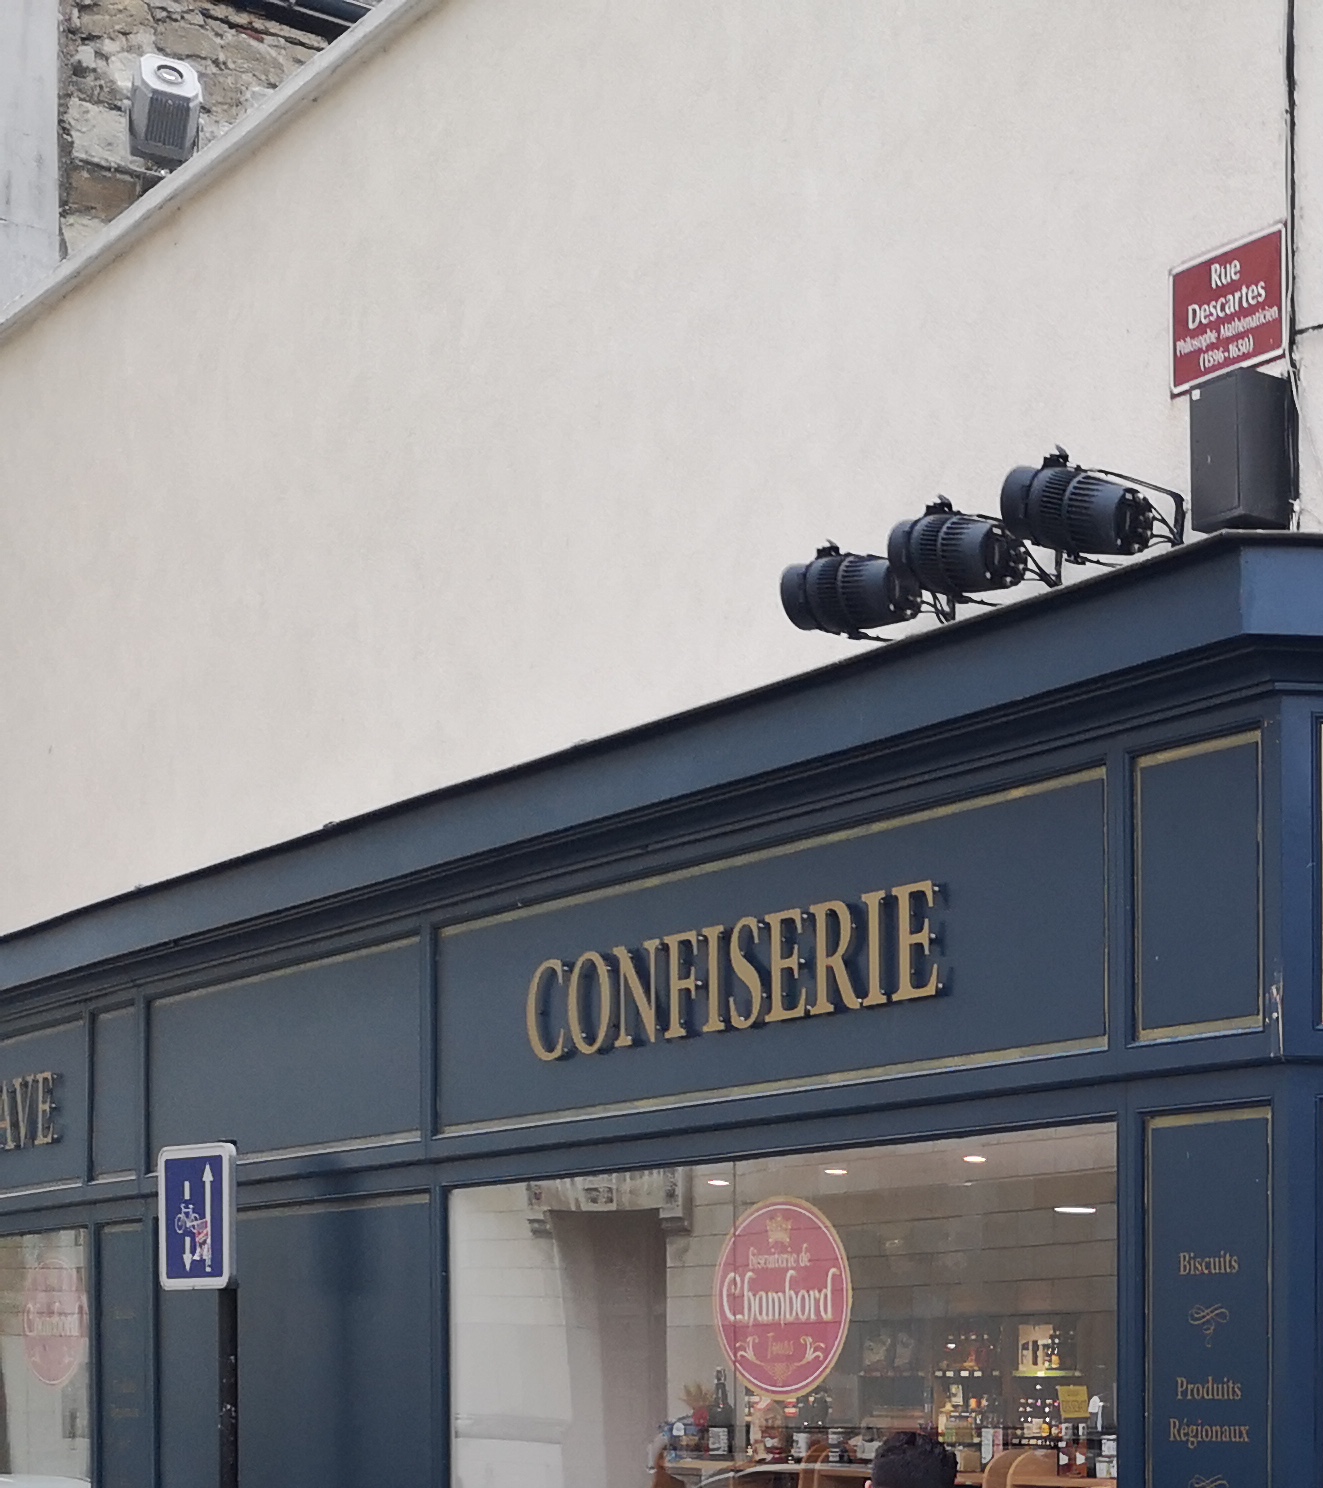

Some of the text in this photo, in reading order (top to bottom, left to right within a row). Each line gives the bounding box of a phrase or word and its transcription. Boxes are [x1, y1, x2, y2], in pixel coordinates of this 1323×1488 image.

[1211, 260, 1240, 289] Rue
[1188, 281, 1265, 329] Descartes
[527, 880, 942, 1062] CONFISERIE
[800, 1243, 811, 1266] de
[1179, 1251, 1239, 1276] Biscuits
[723, 1268, 840, 1327] Chambord
[1176, 1377, 1242, 1401] Produits
[1169, 1418, 1249, 1448] Régionaux
